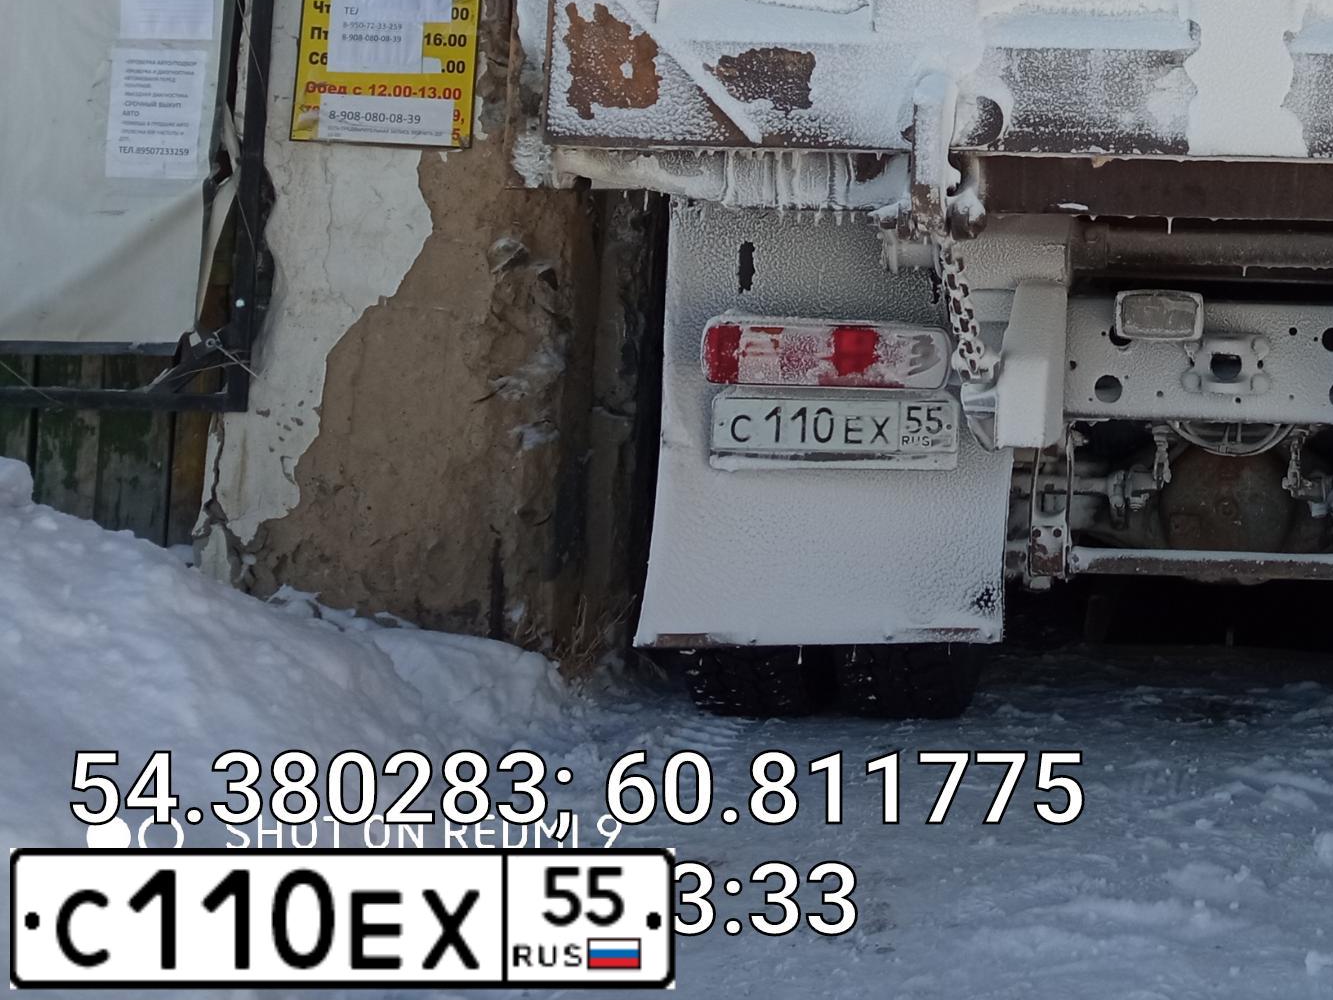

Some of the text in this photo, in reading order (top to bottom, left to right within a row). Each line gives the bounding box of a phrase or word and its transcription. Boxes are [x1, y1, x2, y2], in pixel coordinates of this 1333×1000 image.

[424, 33, 467, 47] 16.00
[306, 81, 347, 95] Обед
[368, 84, 462, 100] 12.00-13.00
[328, 110, 421, 125] 8-908-080-08-39
[906, 405, 943, 434] 55
